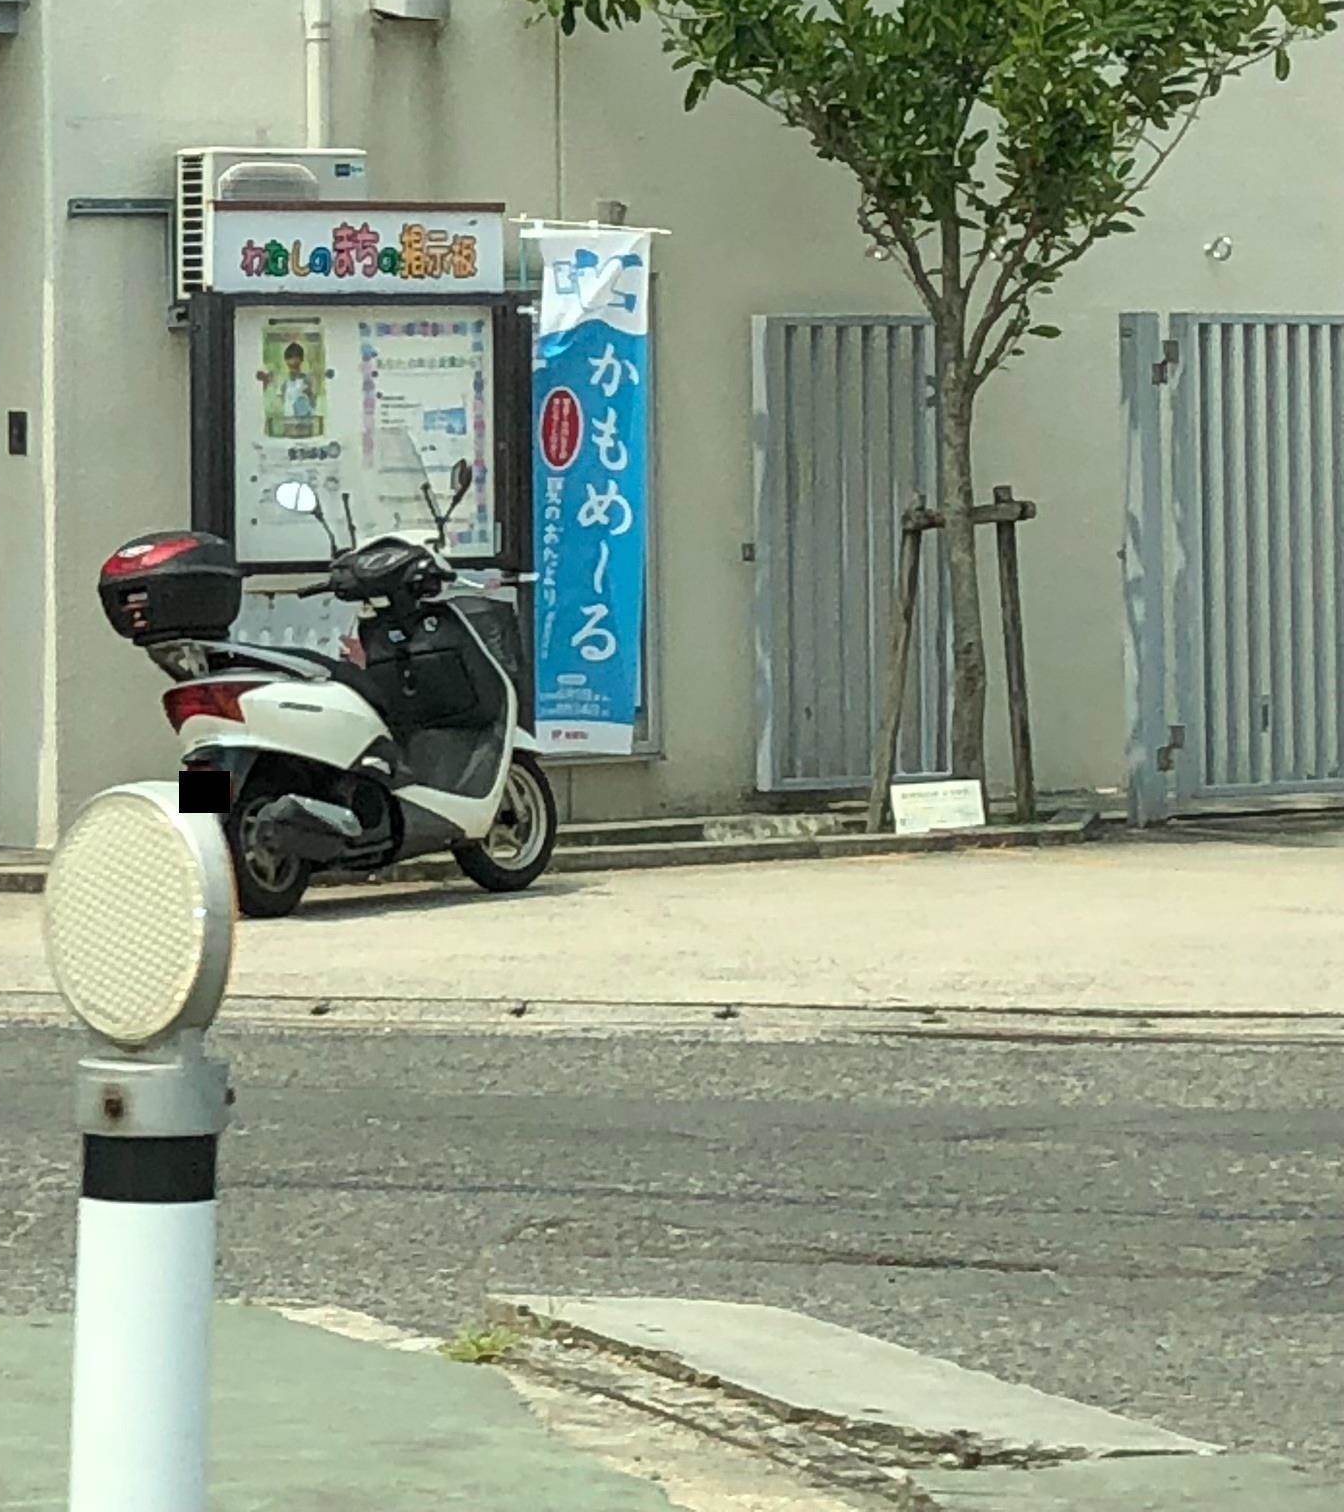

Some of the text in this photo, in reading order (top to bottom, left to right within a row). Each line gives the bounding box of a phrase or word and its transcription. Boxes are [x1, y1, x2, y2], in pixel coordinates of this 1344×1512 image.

[240, 222, 478, 279] わたしのまちの掲示板
